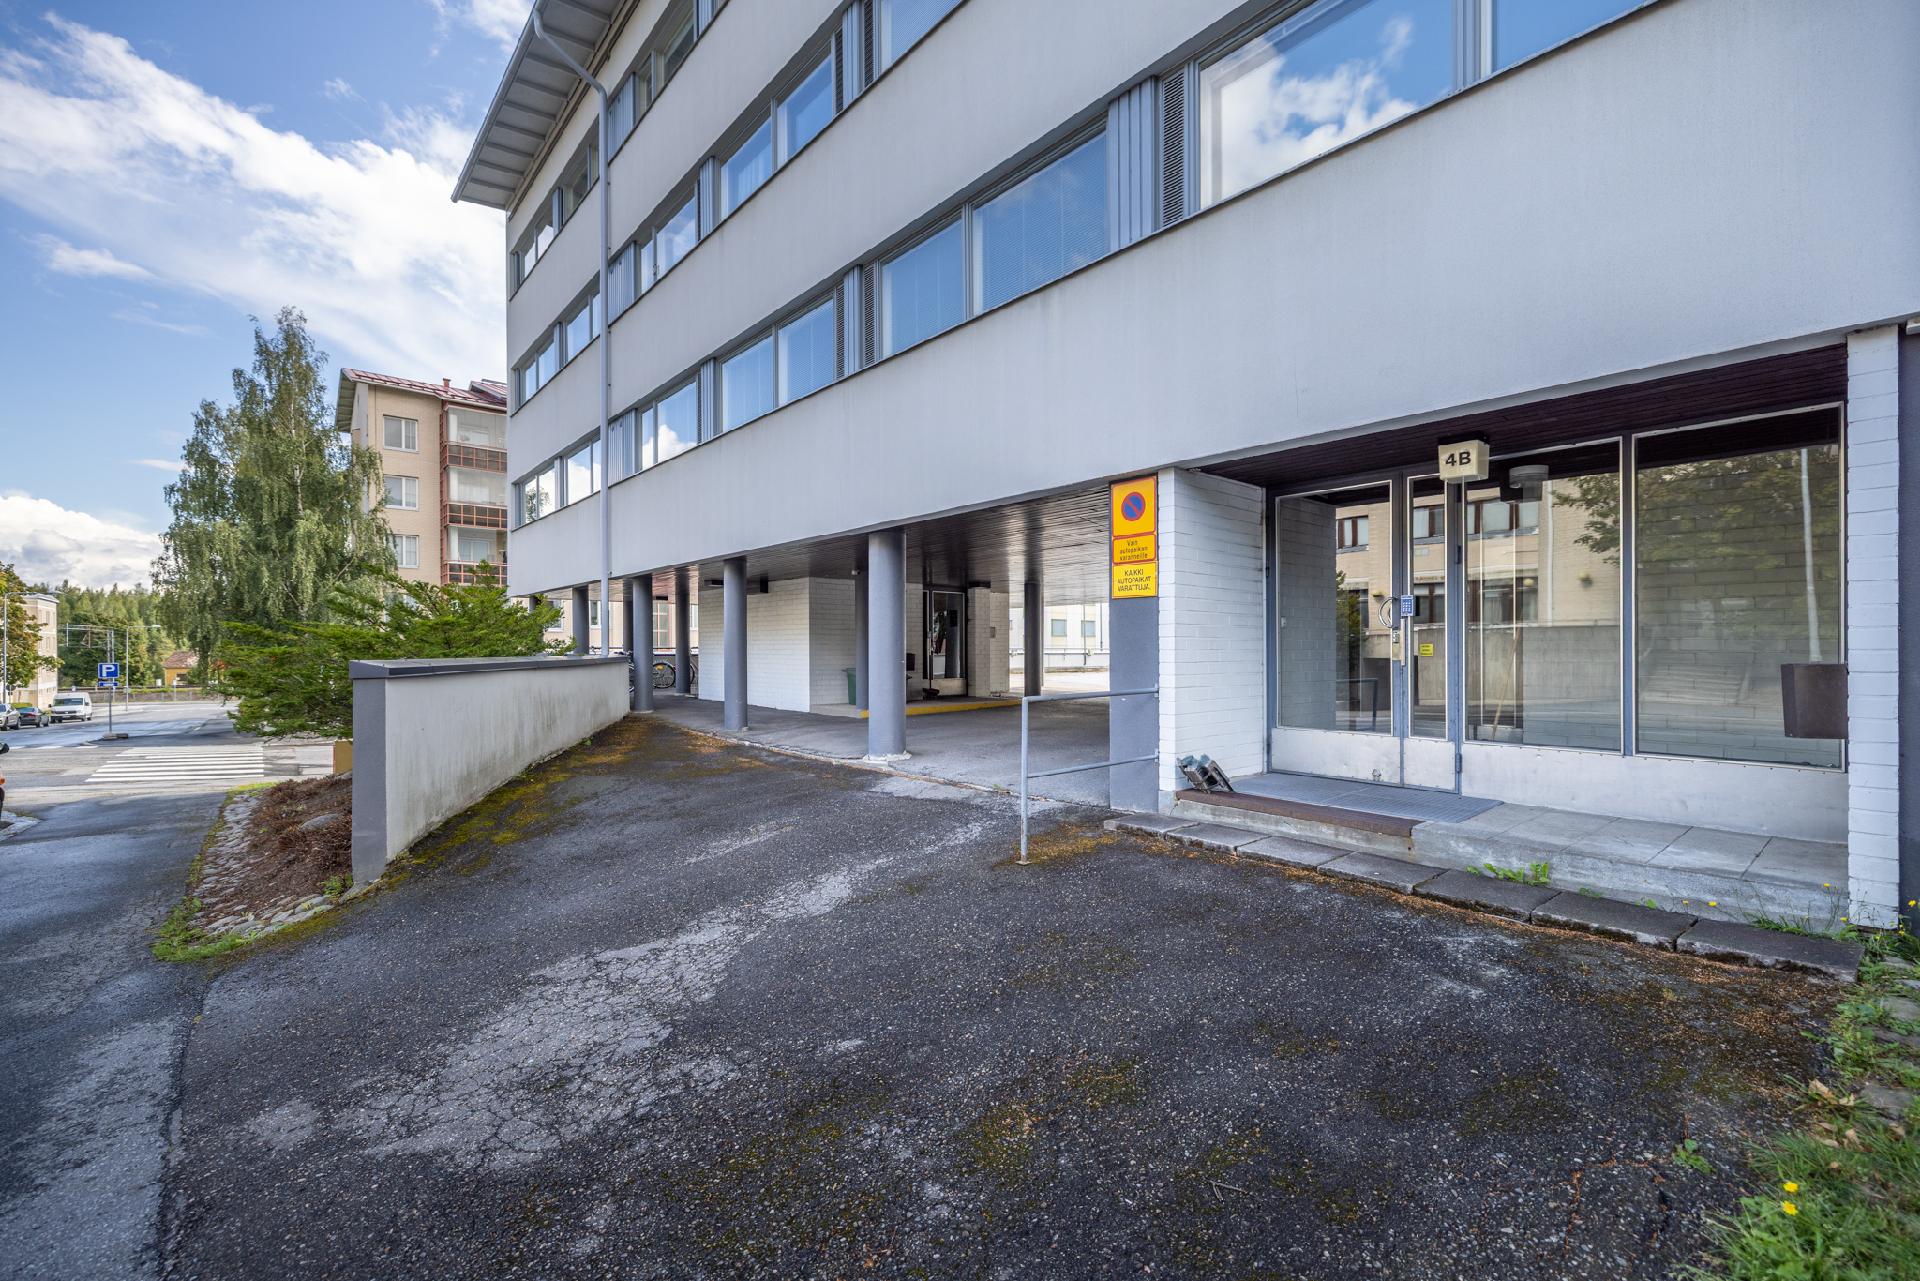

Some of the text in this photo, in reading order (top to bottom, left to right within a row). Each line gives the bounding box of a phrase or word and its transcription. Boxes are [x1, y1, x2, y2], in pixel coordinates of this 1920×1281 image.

[1445, 451, 1471, 466] 4B
[1117, 575, 1151, 584] AUTOPAIKAT
[102, 665, 115, 677] P
